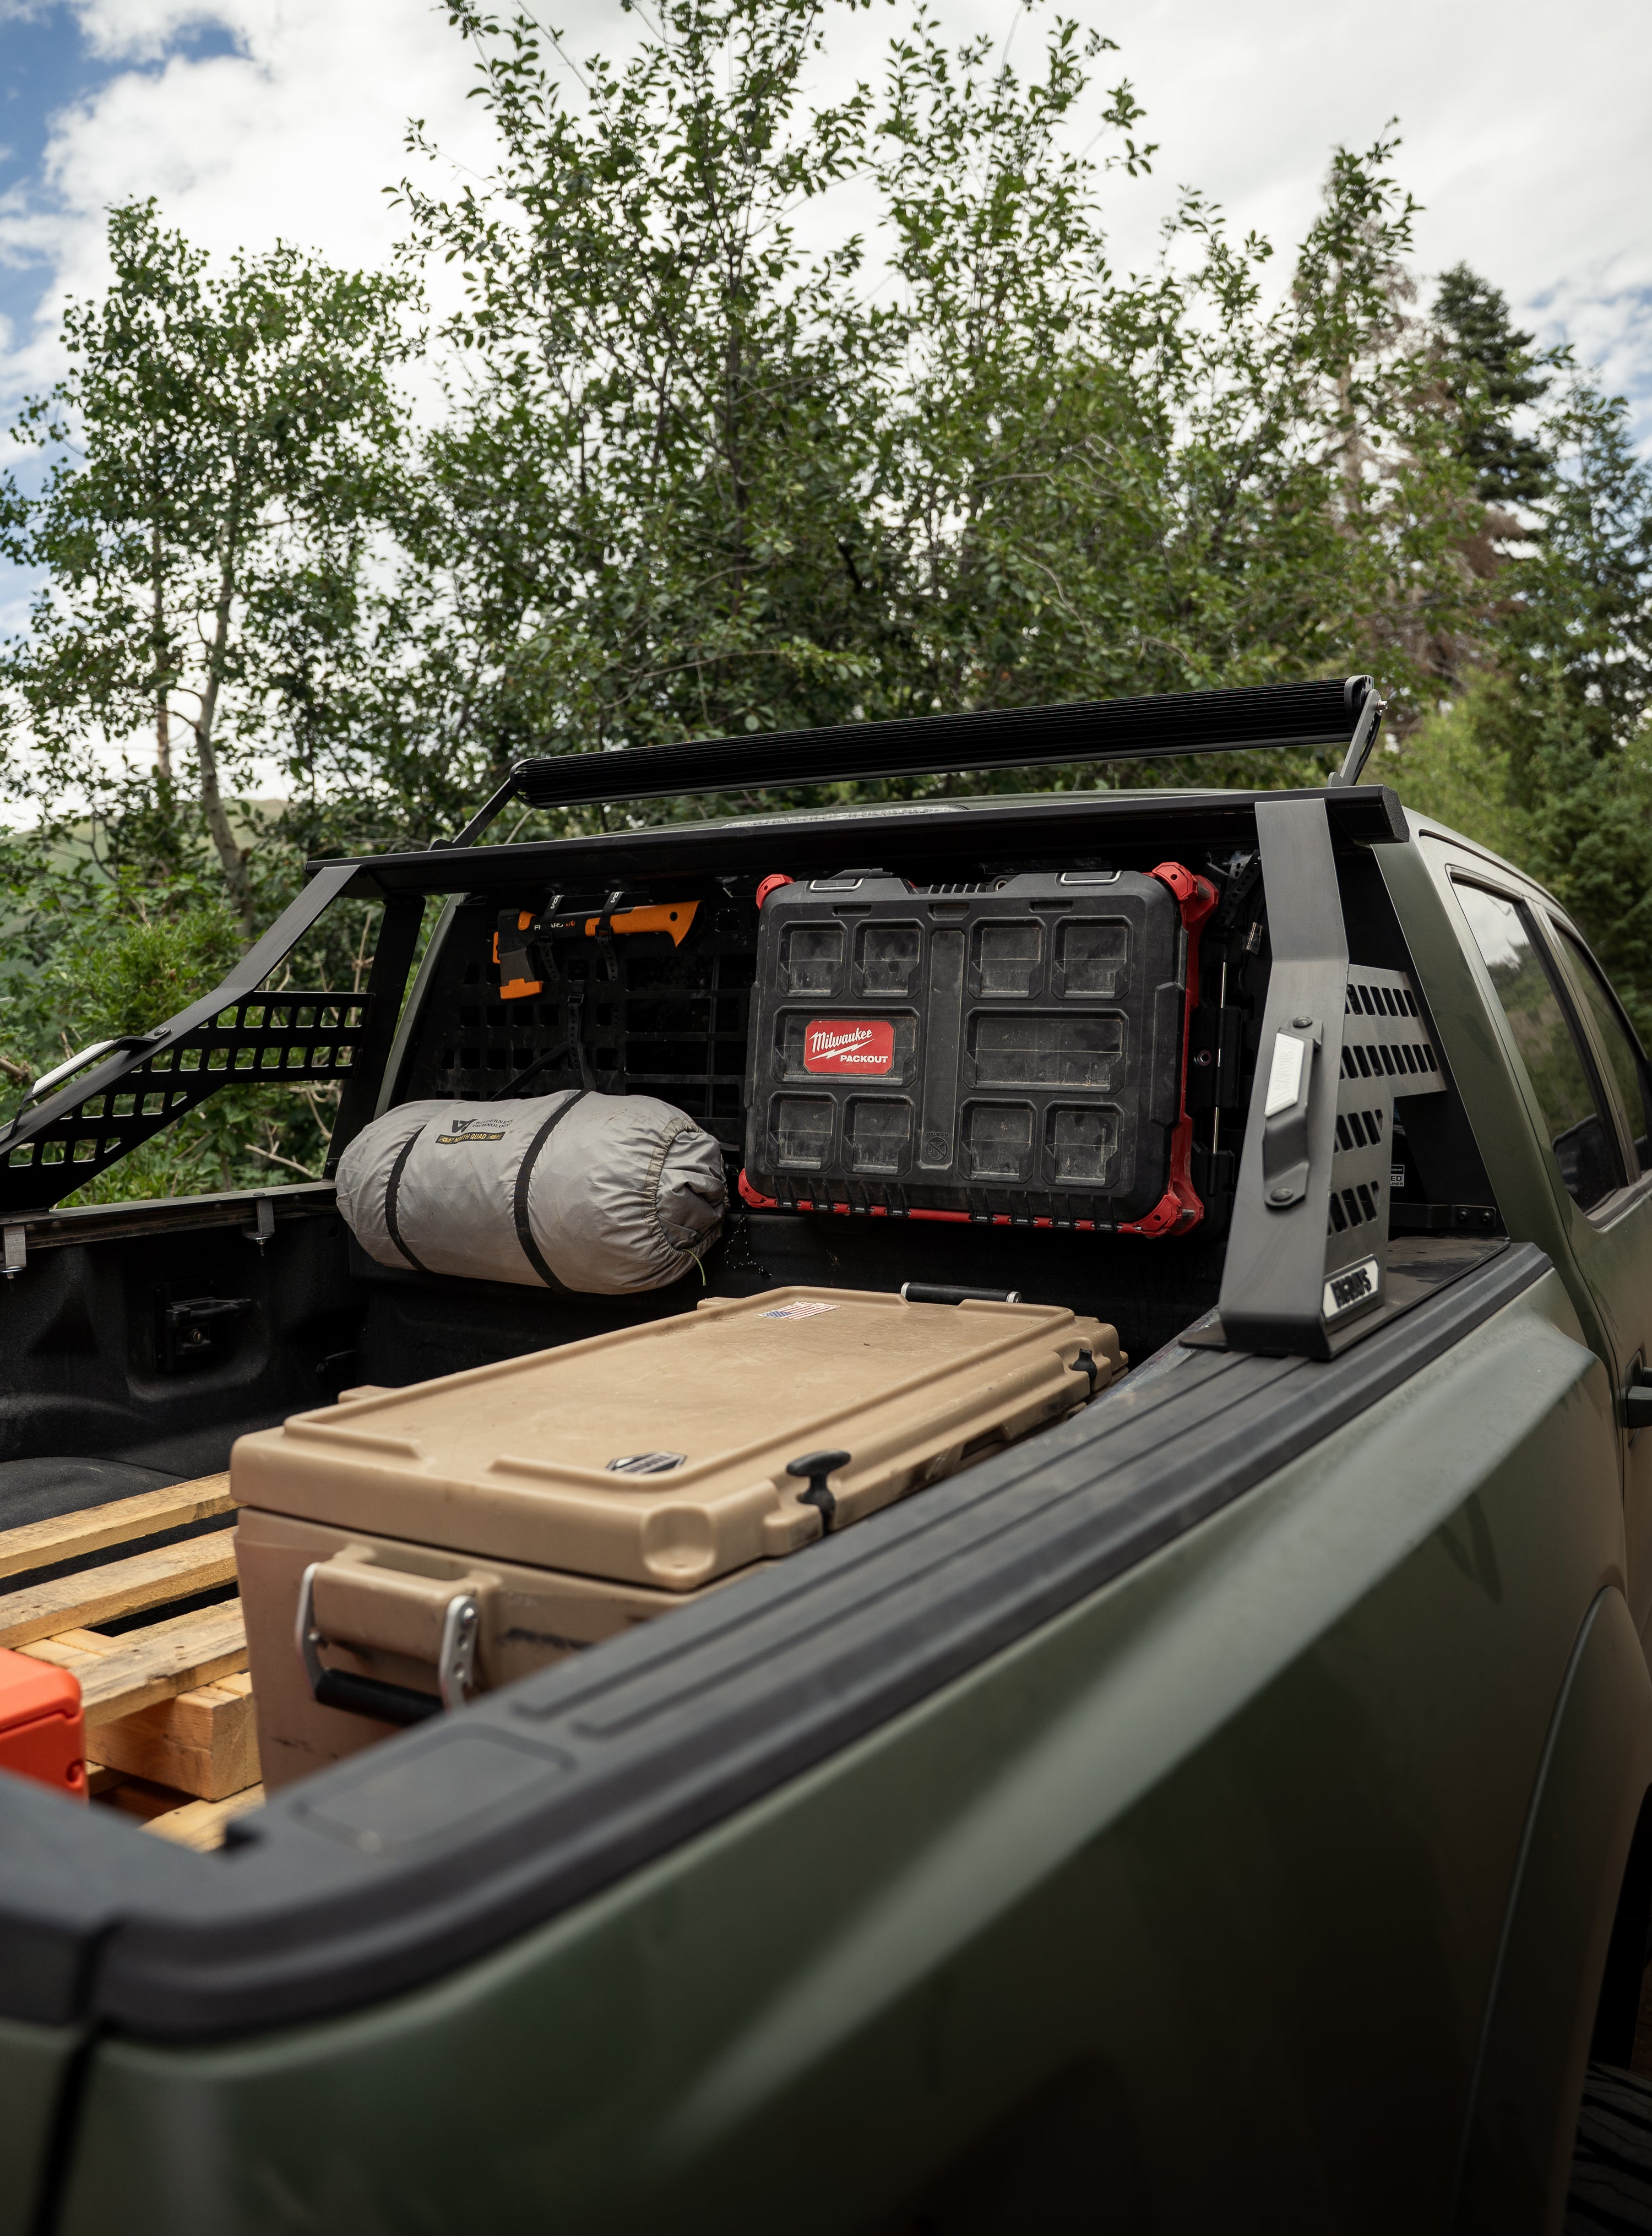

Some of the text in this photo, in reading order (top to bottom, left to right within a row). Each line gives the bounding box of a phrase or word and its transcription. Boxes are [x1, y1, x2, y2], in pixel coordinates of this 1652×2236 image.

[610, 891, 621, 903] VO
[534, 922, 563, 931] FIAR
[808, 1027, 873, 1053] Milwaukee
[840, 1055, 888, 1063] PACKOUT
[453, 1134, 471, 1143] NORTH
